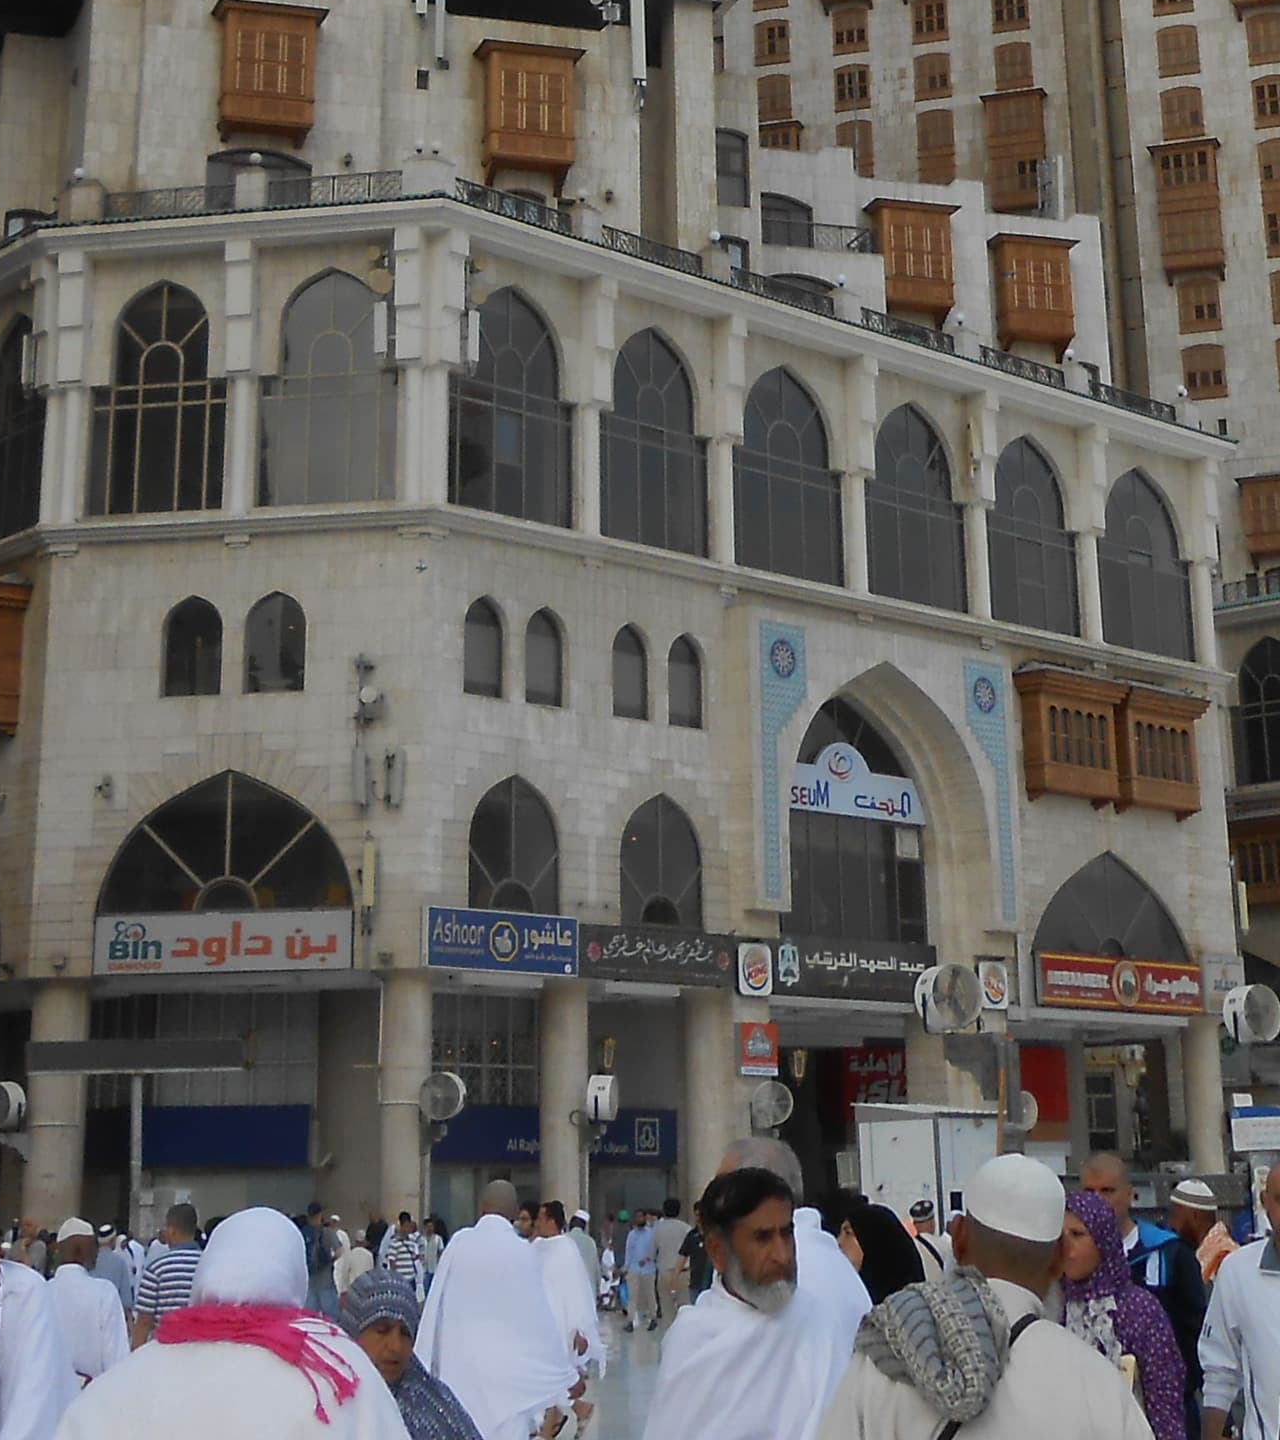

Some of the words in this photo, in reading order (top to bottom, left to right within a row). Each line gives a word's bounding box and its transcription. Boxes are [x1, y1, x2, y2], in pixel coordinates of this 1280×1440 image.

[433, 913, 485, 945] Ashoor
[523, 922, 572, 951] عاشور
[171, 920, 273, 966] داود
[286, 928, 337, 963] بن
[805, 951, 857, 972] القرشي
[859, 956, 897, 973] الصمد
[898, 961, 926, 976] عبد
[506, 1137, 518, 1152] Al
